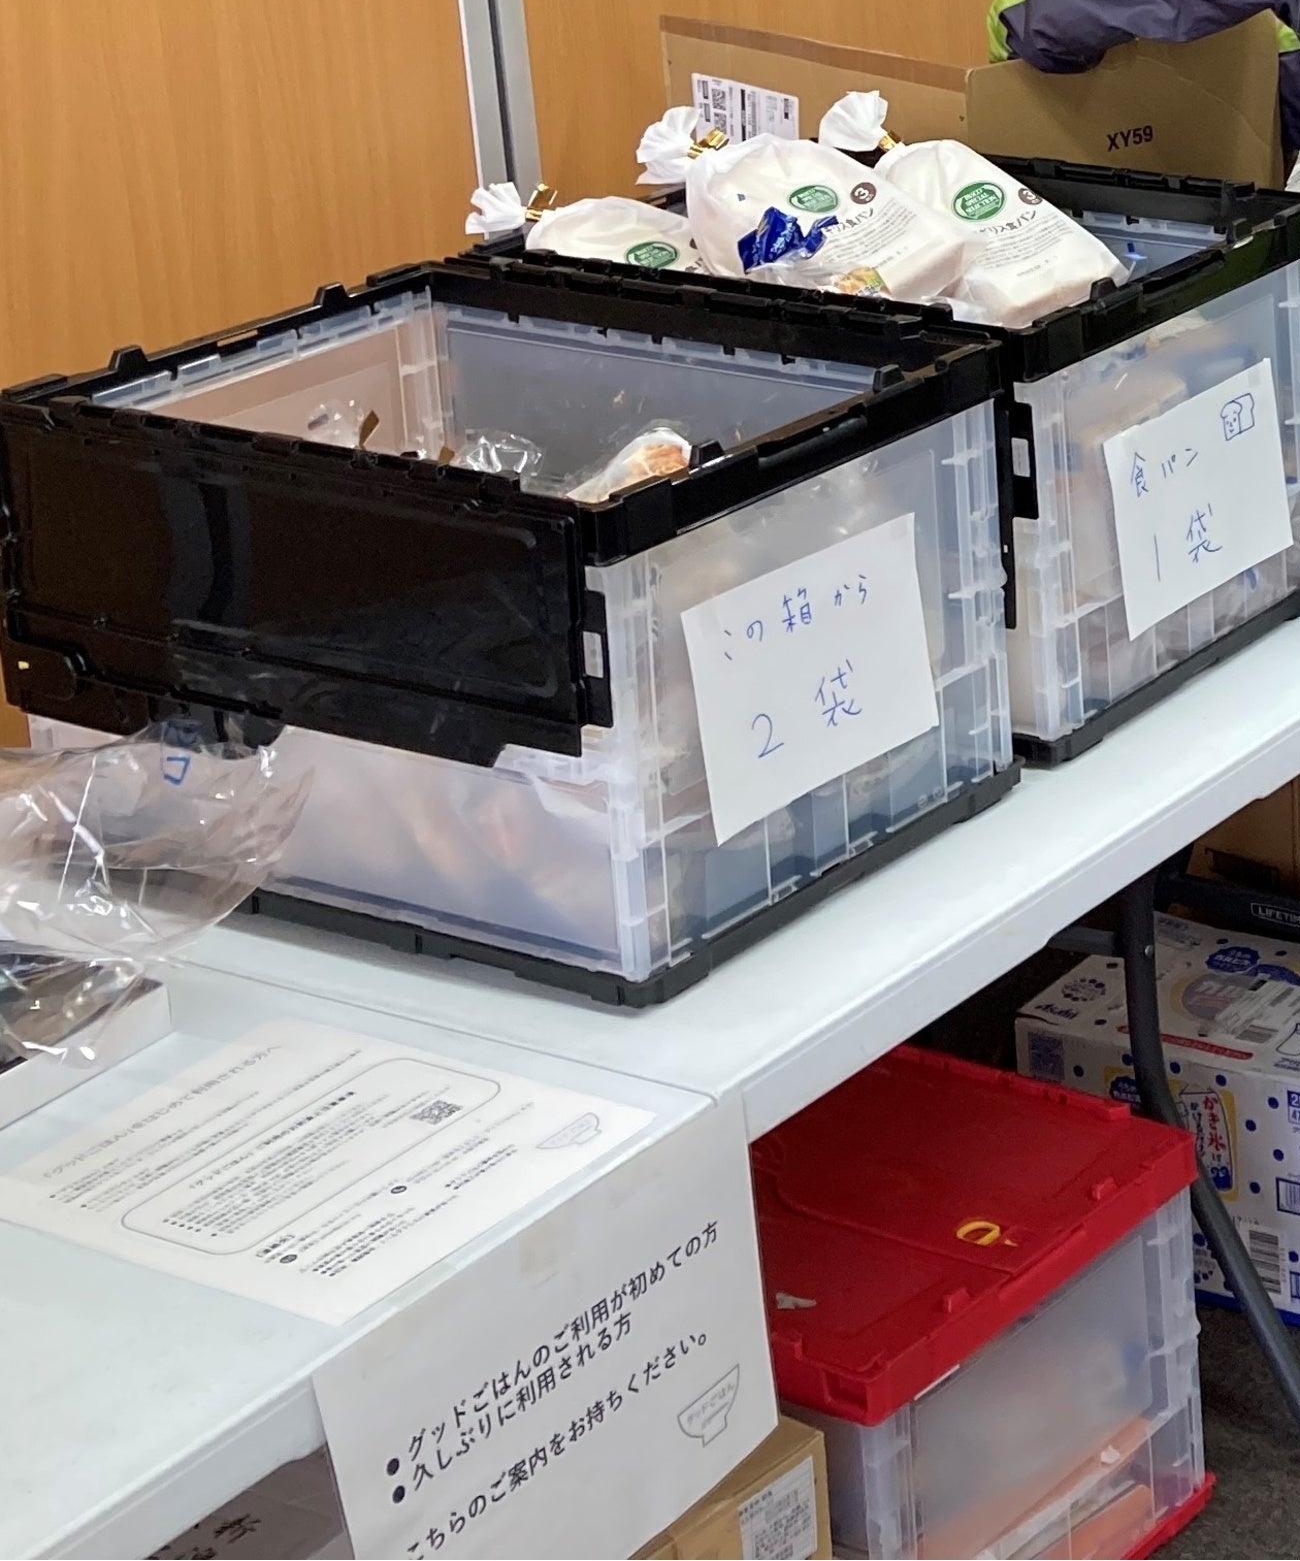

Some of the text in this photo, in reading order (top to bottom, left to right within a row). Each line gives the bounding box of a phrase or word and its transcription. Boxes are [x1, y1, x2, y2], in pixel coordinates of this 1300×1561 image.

[1104, 124, 1155, 153] XY59
[854, 186, 870, 201] 3
[1129, 444, 1200, 500] 食パン
[721, 571, 871, 663] この箱から
[407, 1219, 718, 1462] グッドごはんのご利用が初めての方
[413, 1311, 633, 1492] 久しぶりに利用される方
